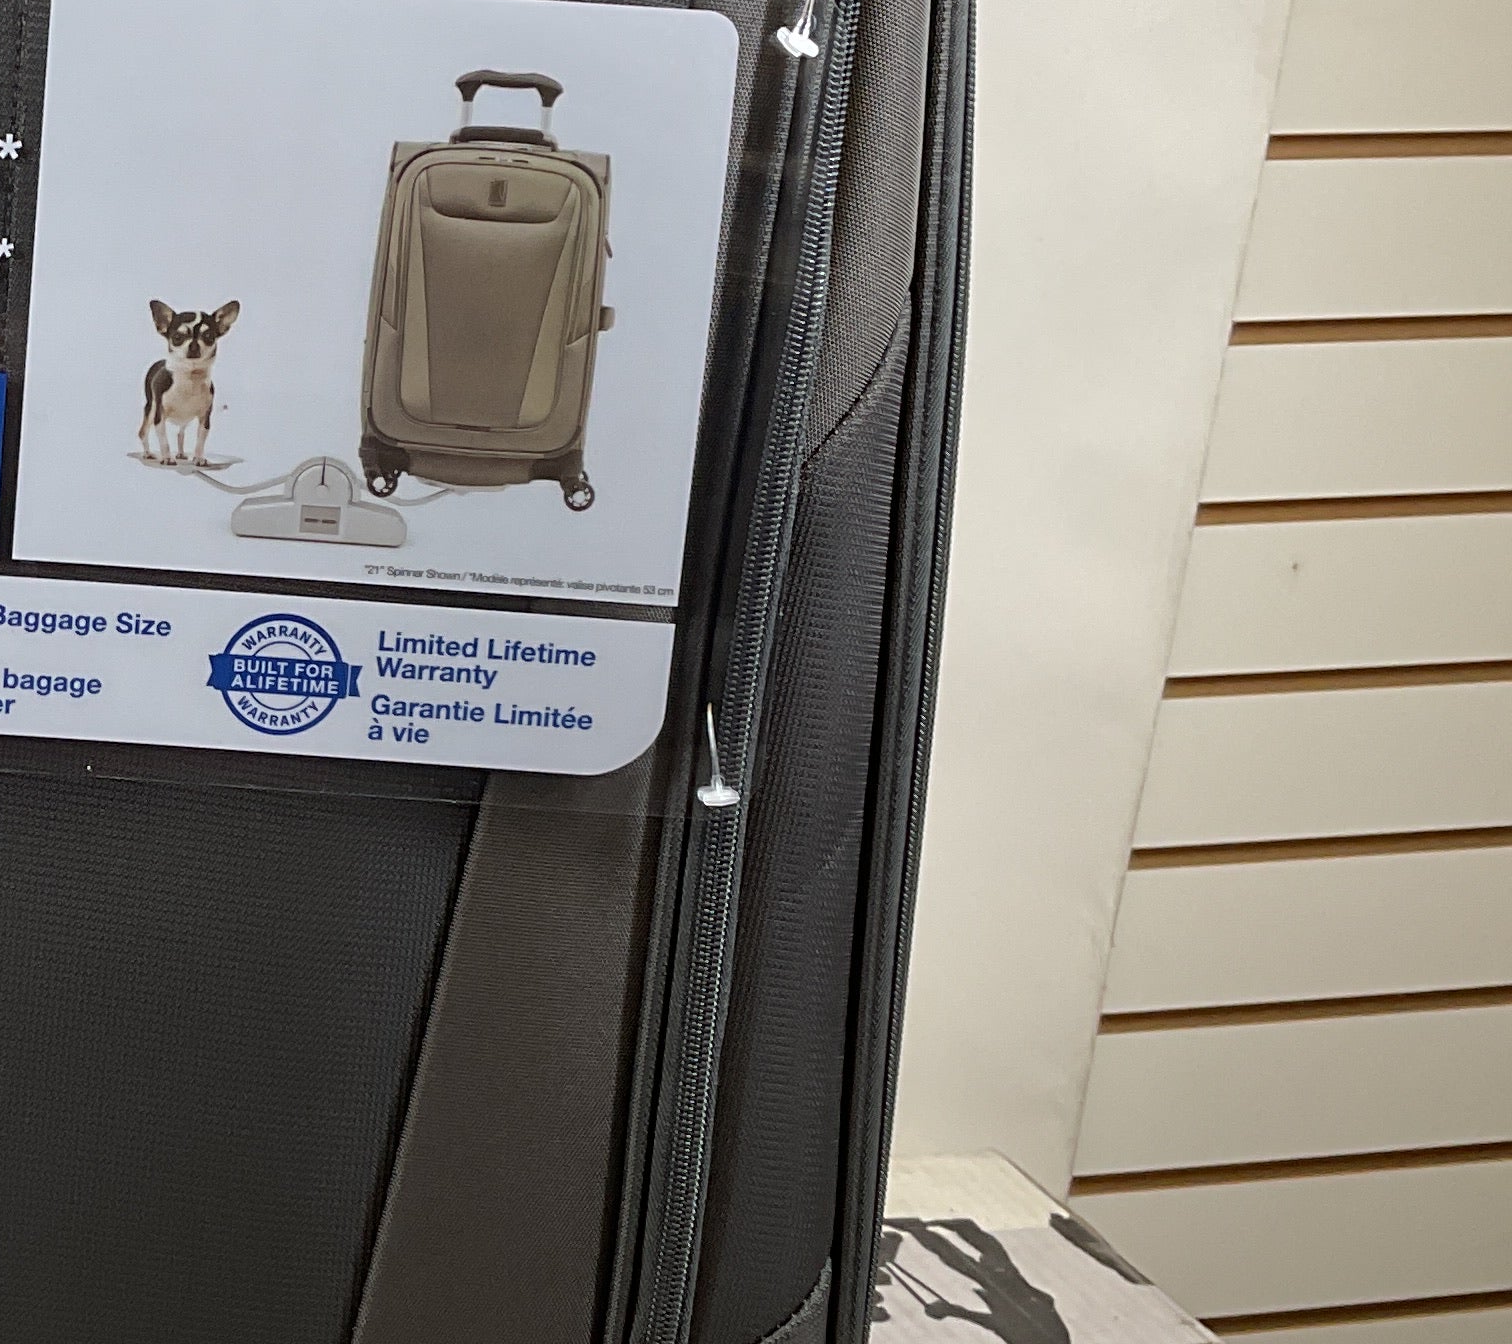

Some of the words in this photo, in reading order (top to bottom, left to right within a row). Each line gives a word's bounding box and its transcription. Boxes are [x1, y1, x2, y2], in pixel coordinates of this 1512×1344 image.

[657, 588, 674, 596] cm
[116, 613, 171, 636] Size
[241, 624, 328, 657] WARRANTY
[379, 631, 478, 657] Limited
[488, 639, 596, 666] Lifetime
[3, 668, 101, 698] bagage
[233, 658, 288, 676] BUILT
[294, 663, 334, 679] FOR
[377, 656, 497, 689] Warranty
[237, 695, 319, 727] WARRANTY
[371, 694, 484, 723] Garantie
[495, 703, 592, 730] Limitée
[368, 718, 382, 740] à
[393, 723, 429, 743] vie
